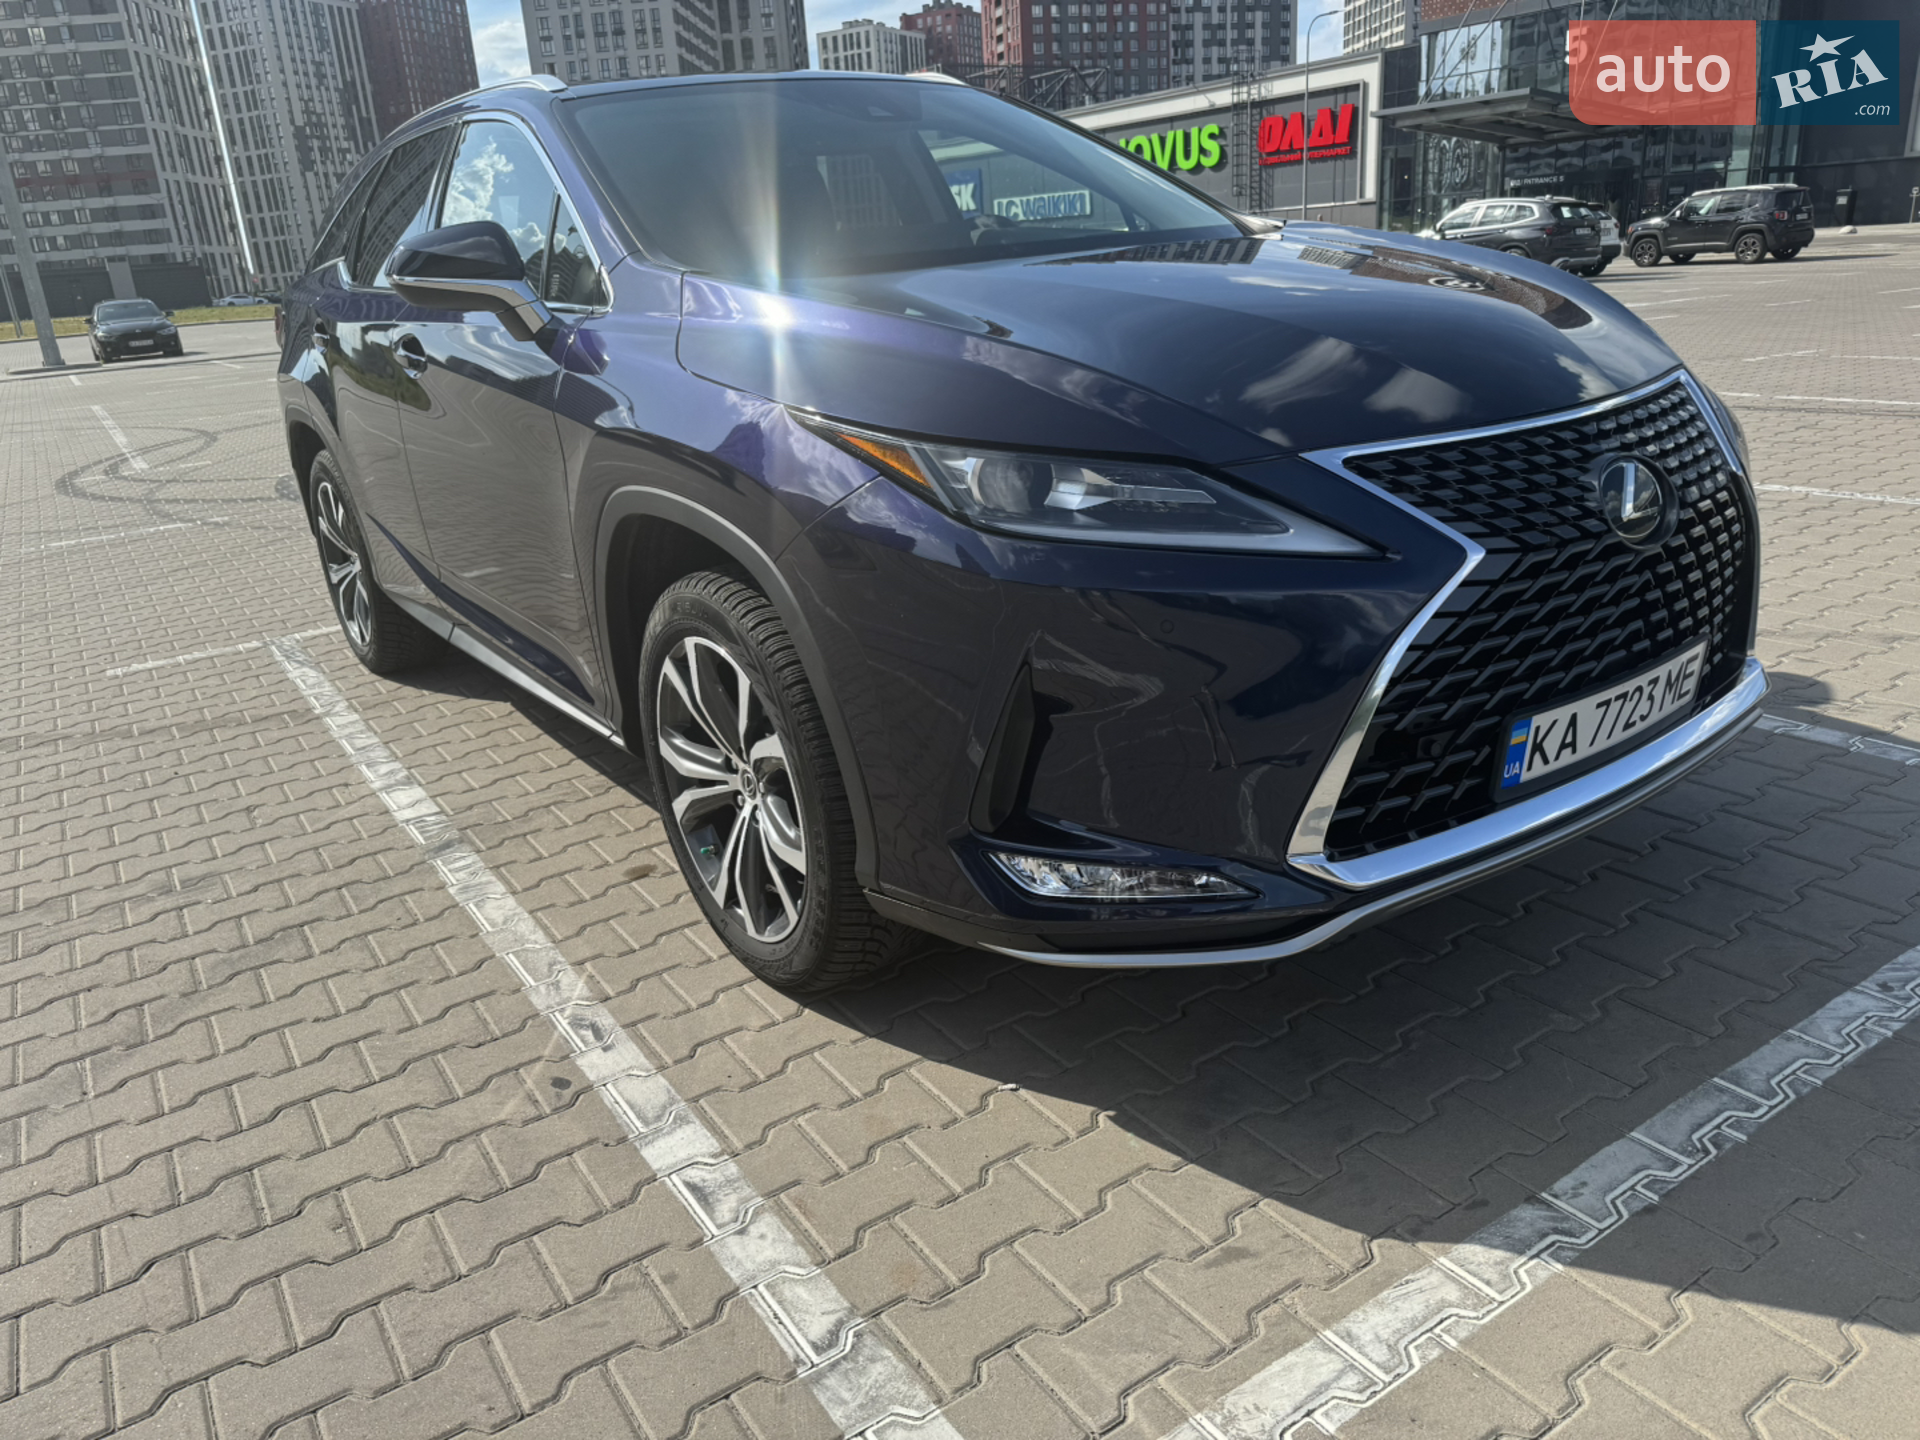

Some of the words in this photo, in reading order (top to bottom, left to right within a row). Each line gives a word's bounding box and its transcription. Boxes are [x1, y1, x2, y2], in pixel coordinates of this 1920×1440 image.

[1257, 103, 1355, 152] ОЛДІ
[1525, 711, 1578, 772] KA
[1589, 675, 1660, 748] 7723
[1658, 652, 1700, 713] ME
[1503, 761, 1521, 778] UA
